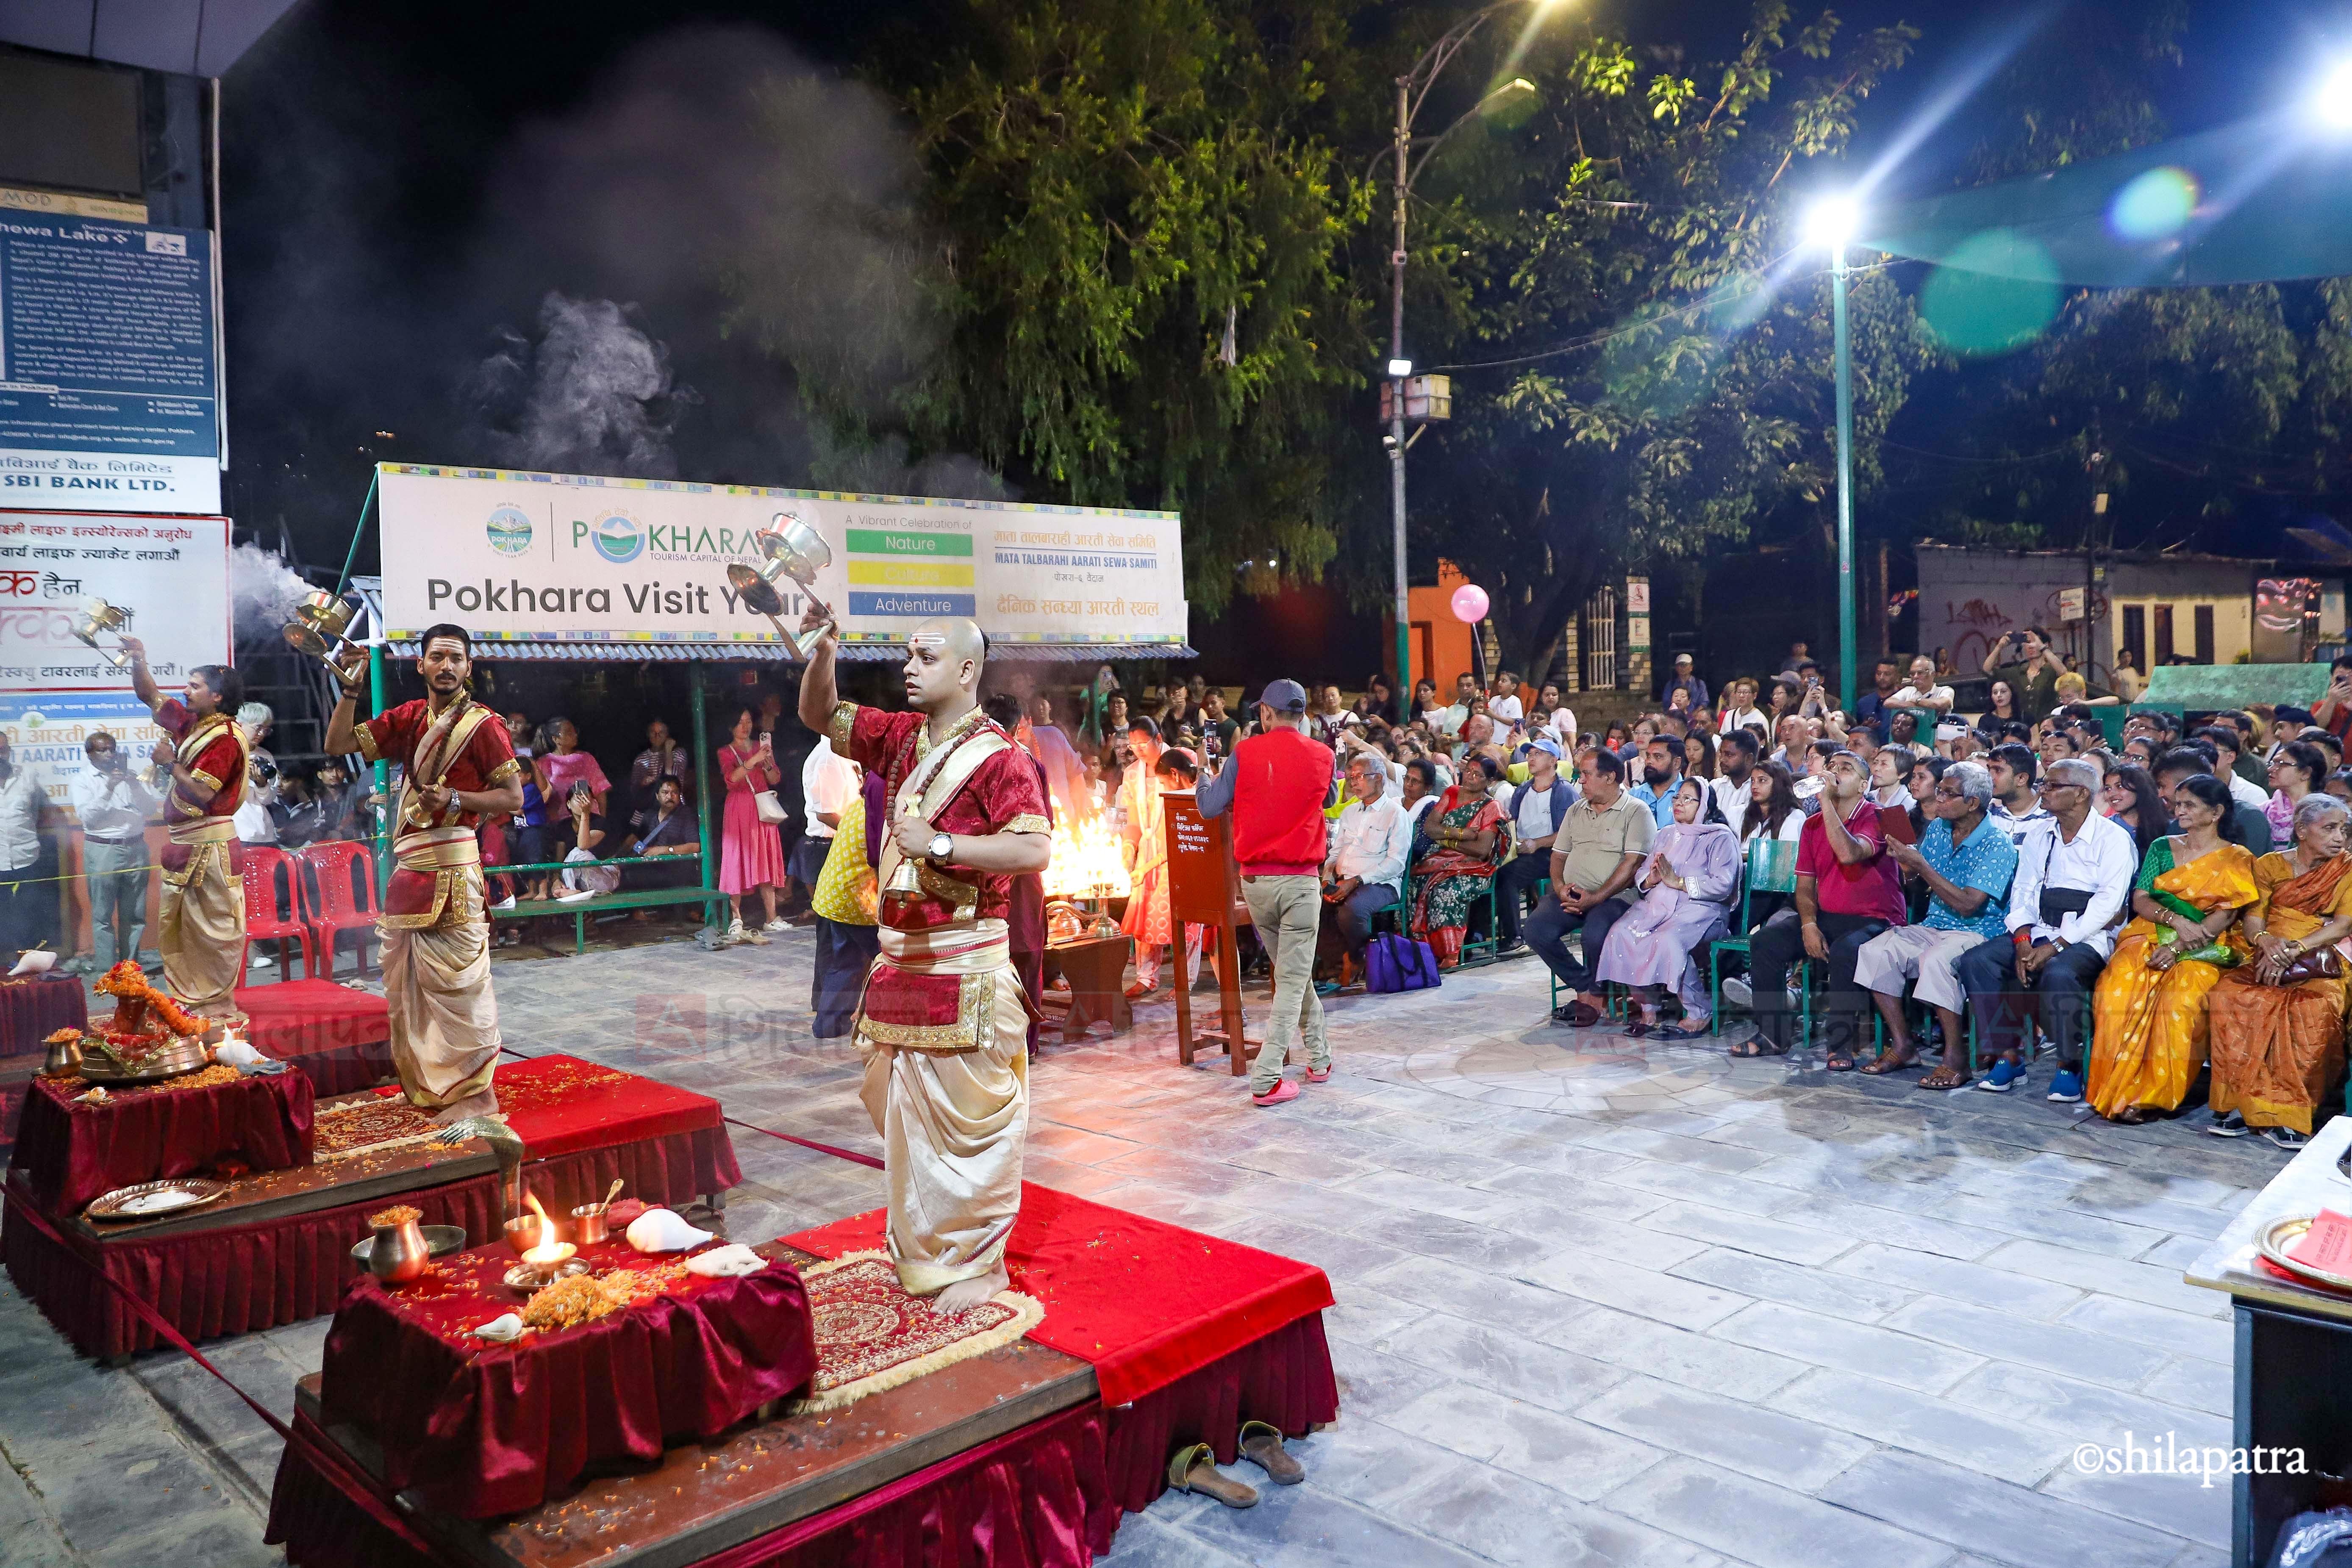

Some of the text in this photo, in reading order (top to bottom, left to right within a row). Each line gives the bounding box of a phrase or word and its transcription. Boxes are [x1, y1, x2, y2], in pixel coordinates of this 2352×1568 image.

[4, 475, 175, 492] SBI BANK LTD.
[845, 515, 973, 529] A Vibrant Celebration of
[491, 536, 528, 544] POKHARA
[886, 536, 936, 550] Nature
[994, 530, 1016, 543] माता
[1075, 533, 1103, 546] आरती
[1107, 532, 1125, 547] सेवा
[1128, 533, 1156, 548] समिति
[650, 552, 687, 561] TOURISM
[690, 554, 722, 562] CAPITAL
[738, 555, 761, 563] NEPAL
[995, 552, 1157, 569] MATA TALBARAHI AARATI SEWA SAMITI
[886, 566, 940, 582] Culture
[428, 577, 805, 615] Pokhara Visit Yr
[875, 598, 952, 612] Adventure
[997, 594, 1037, 614] दैनिक
[1086, 597, 1126, 615] आरती
[1129, 600, 1160, 616] स्थल
[22, 747, 81, 762] AARATI
